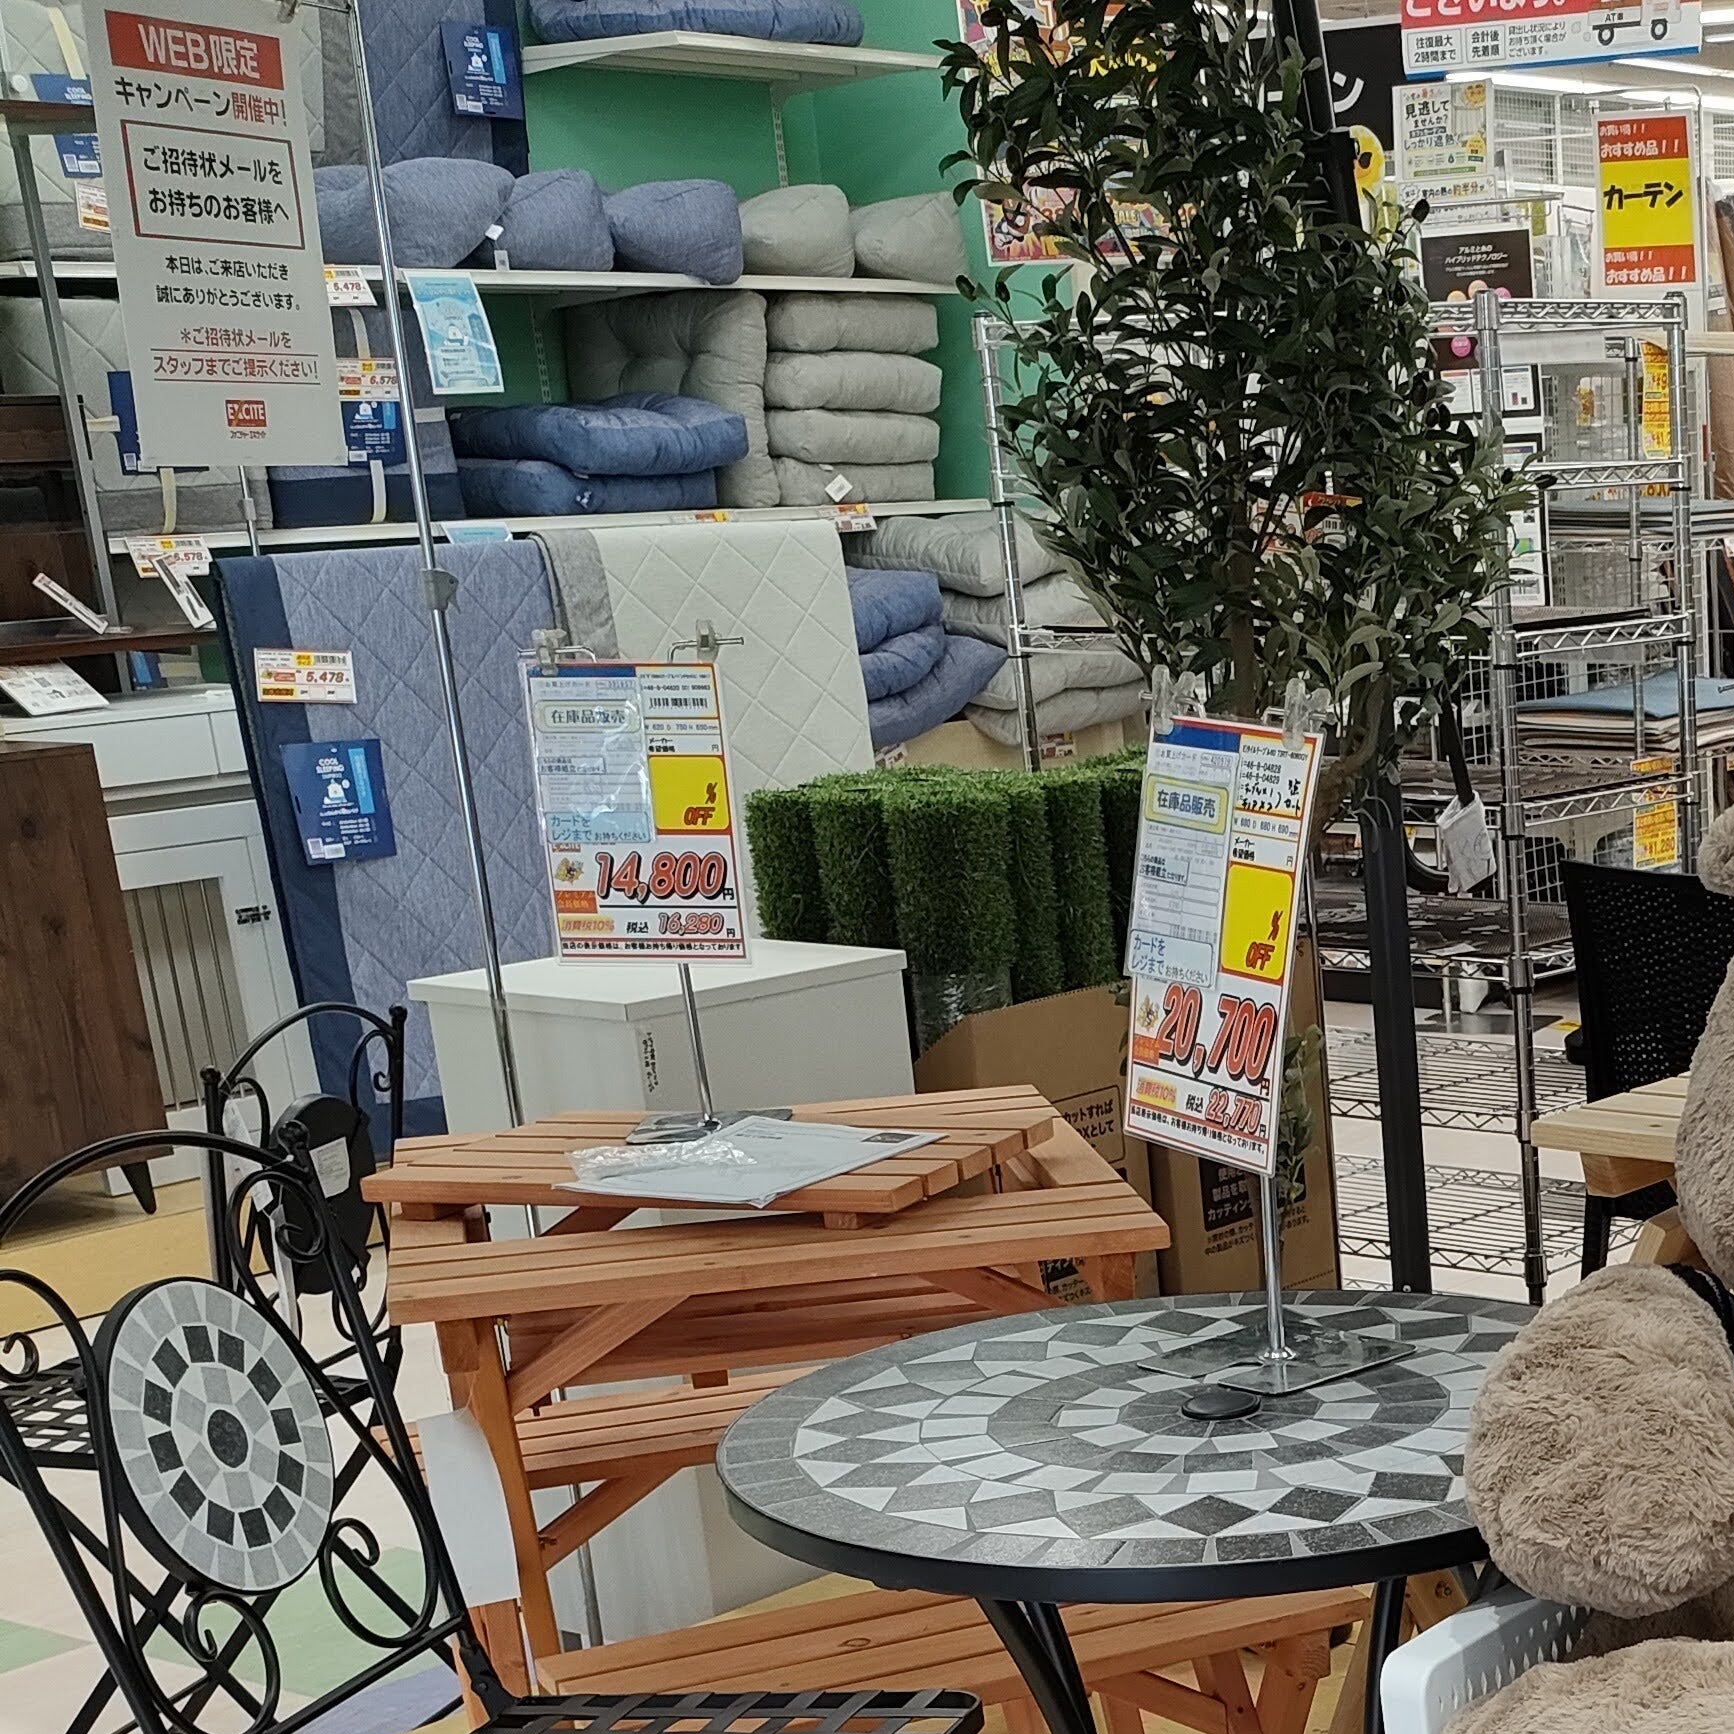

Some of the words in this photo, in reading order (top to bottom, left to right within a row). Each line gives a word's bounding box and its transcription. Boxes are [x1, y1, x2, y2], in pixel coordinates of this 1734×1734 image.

[1416, 36, 1453, 49] 往復最大
[1471, 31, 1499, 43] 会計後
[138, 24, 261, 80] WEB限定
[1414, 50, 1456, 63] 2時間まで
[1471, 44, 1500, 58] 先着順
[1405, 100, 1449, 120] 見逃して
[1600, 139, 1680, 158] おすすめ品！！
[143, 145, 283, 186] ご招待状メールを
[148, 187, 290, 225] お持ちのお客様へ
[1603, 181, 1684, 211] カーテン
[165, 255, 288, 281] 本日は、ご来店いただき
[1606, 266, 1687, 284] おすすめ品！！
[156, 284, 300, 311] 誠にありがとうございます。
[227, 403, 265, 420] EXCITE
[318, 757, 338, 766] COOL
[1157, 788, 1216, 819] 在庫品販売
[551, 815, 590, 828] カードを
[684, 807, 716, 826] OFF
[595, 851, 727, 905] 14,800
[722, 887, 735, 901] 円
[626, 921, 649, 934] 税込
[658, 912, 725, 936] 16,280
[1133, 934, 1165, 957] カードを
[1246, 941, 1275, 971] OFF
[1132, 953, 1164, 976] レジまで
[1156, 982, 1278, 1086] 20,700
[1259, 1080, 1270, 1097] 円
[1185, 1093, 1204, 1114] 税込
[1205, 1086, 1263, 1135] 22,770
